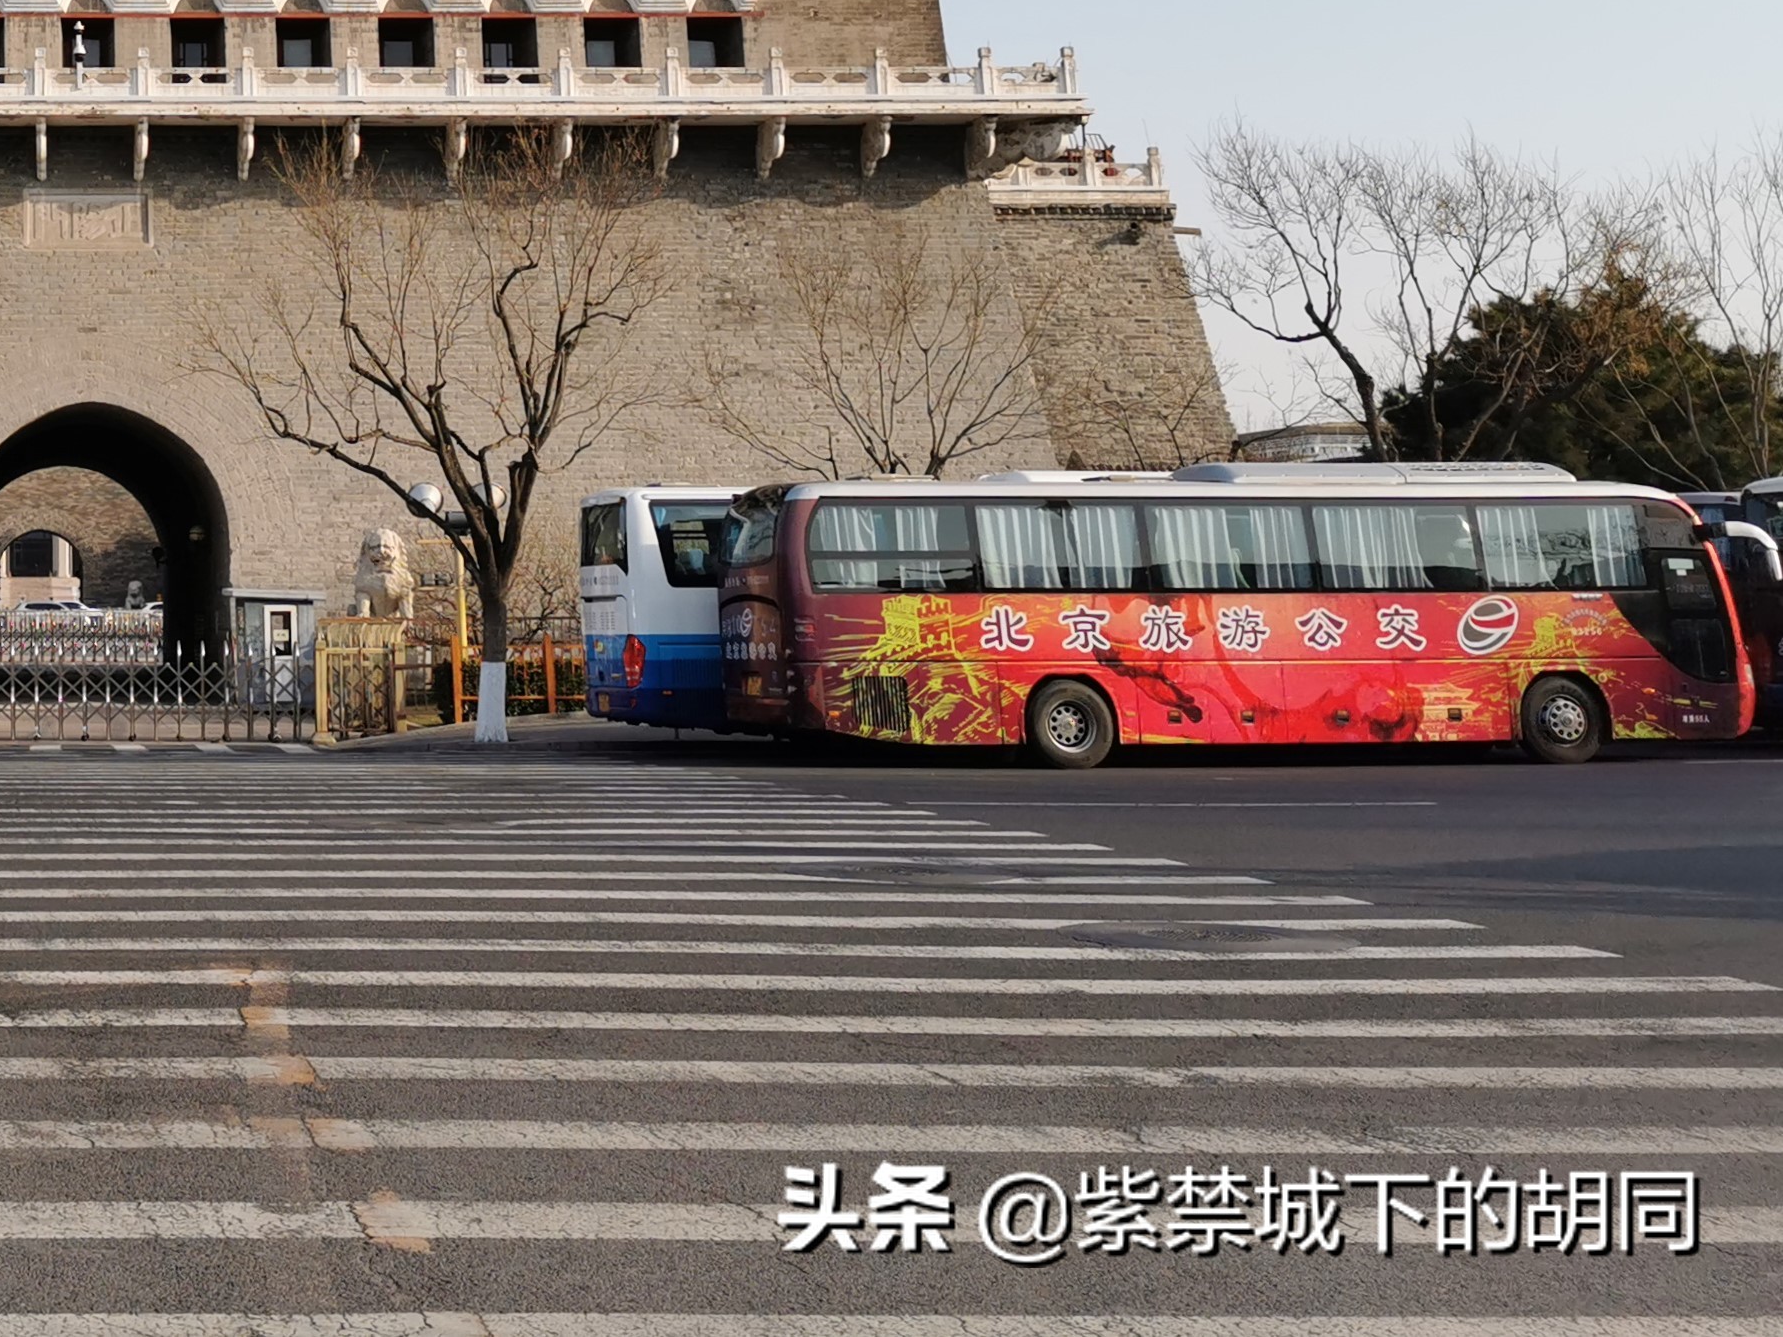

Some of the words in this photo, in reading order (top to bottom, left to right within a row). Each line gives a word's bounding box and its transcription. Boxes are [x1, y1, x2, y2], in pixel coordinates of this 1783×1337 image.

[980, 604, 1428, 653] 北京旅游公交
